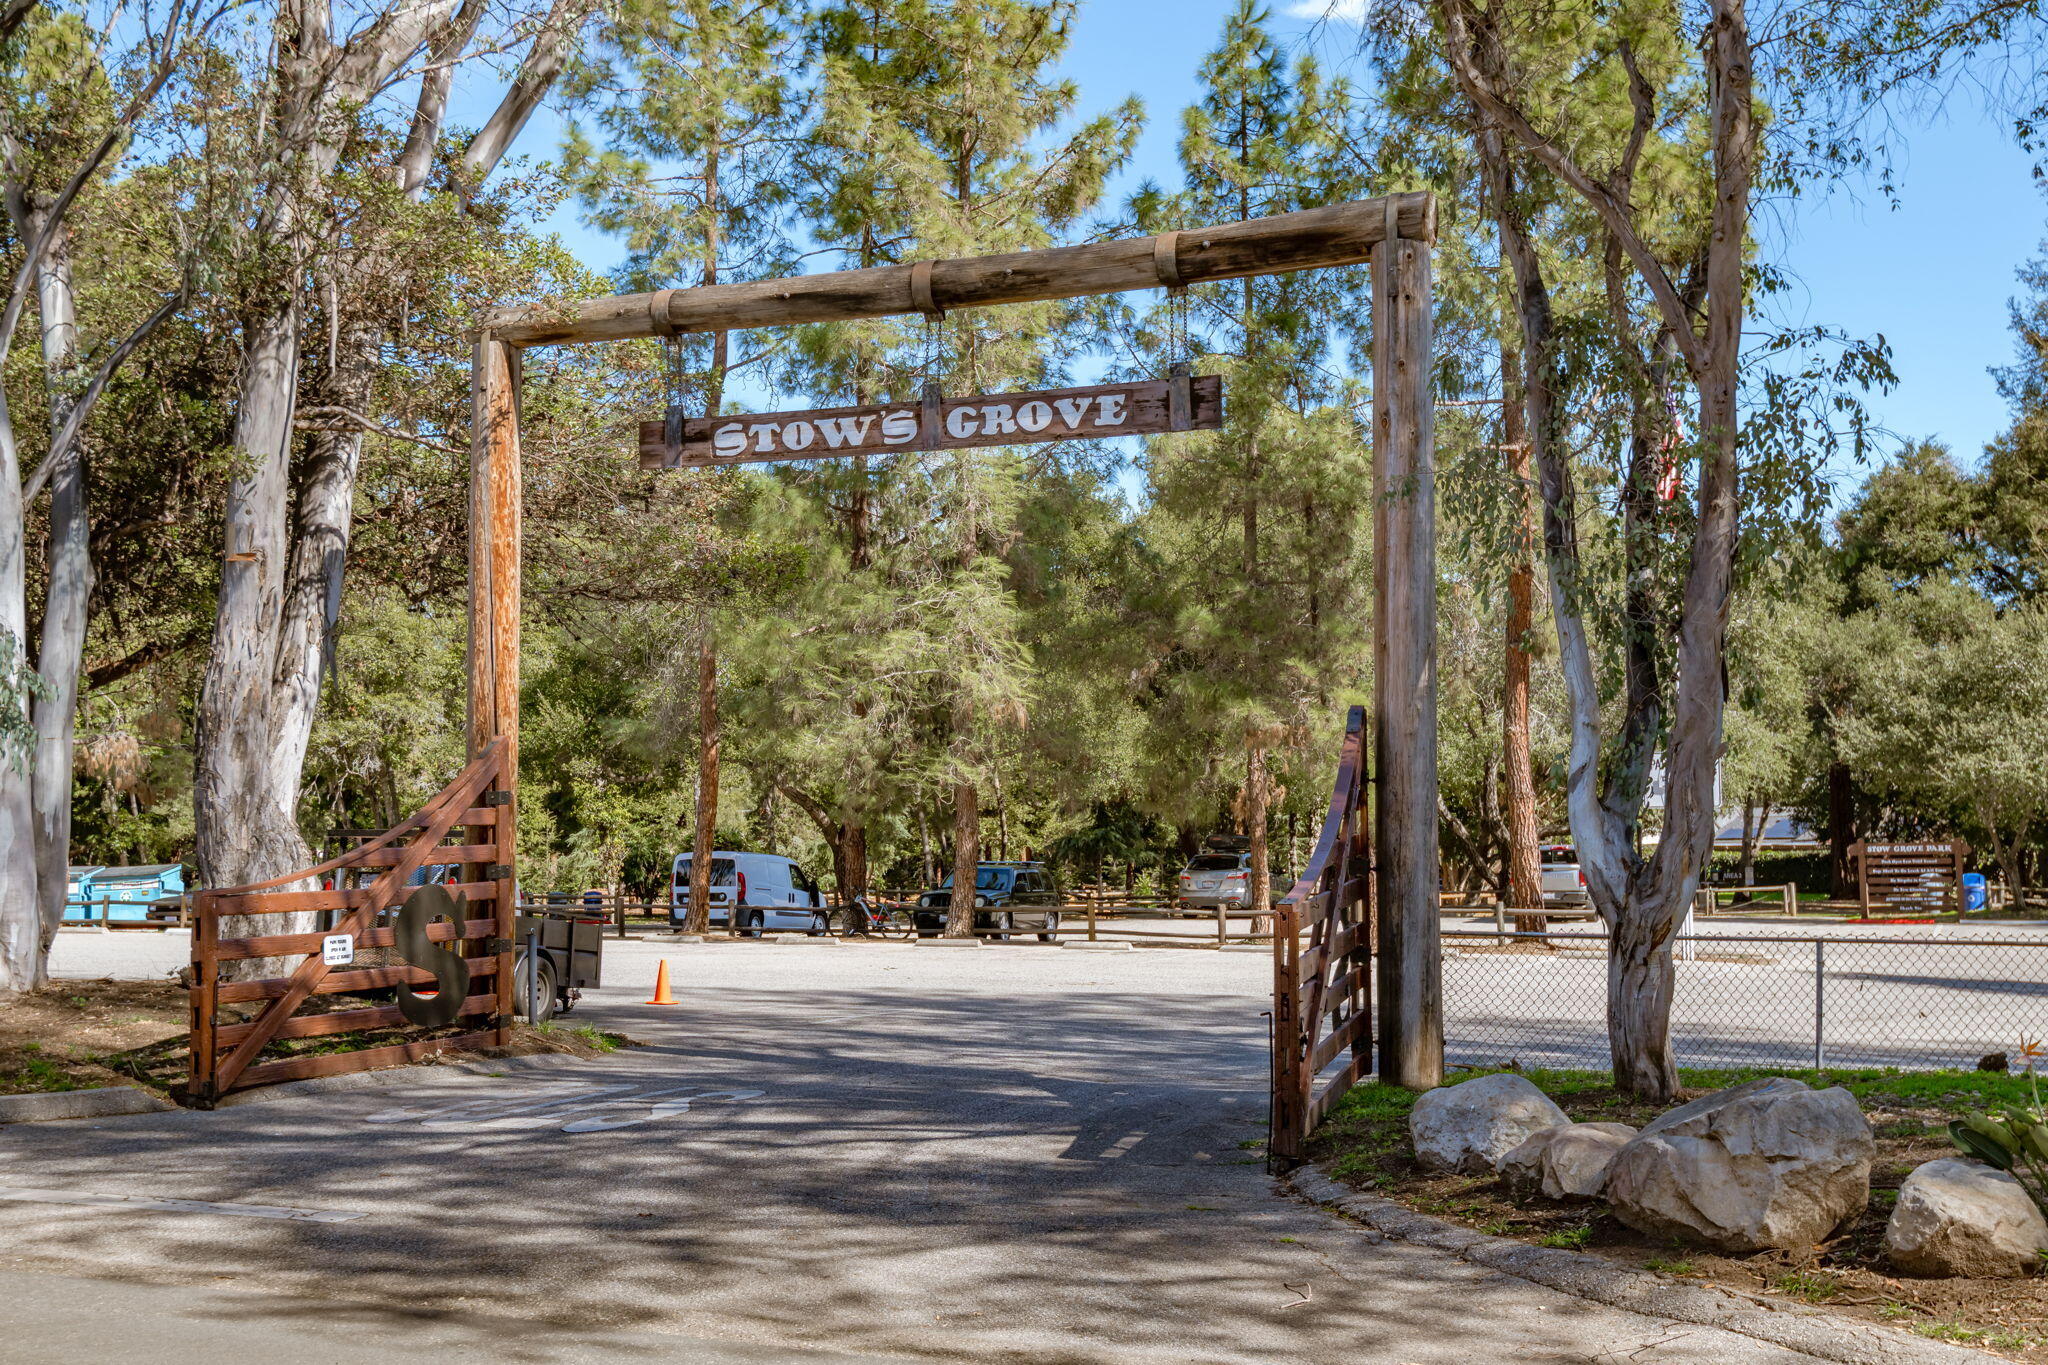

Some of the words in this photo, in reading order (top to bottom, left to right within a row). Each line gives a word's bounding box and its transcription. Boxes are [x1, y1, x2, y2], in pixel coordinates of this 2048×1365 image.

[714, 410, 918, 457] STOW'S
[946, 394, 1128, 439] GROVE
[1867, 845, 1891, 853] STOW
[1926, 844, 1952, 852] PARK
[394, 884, 470, 1028] S
